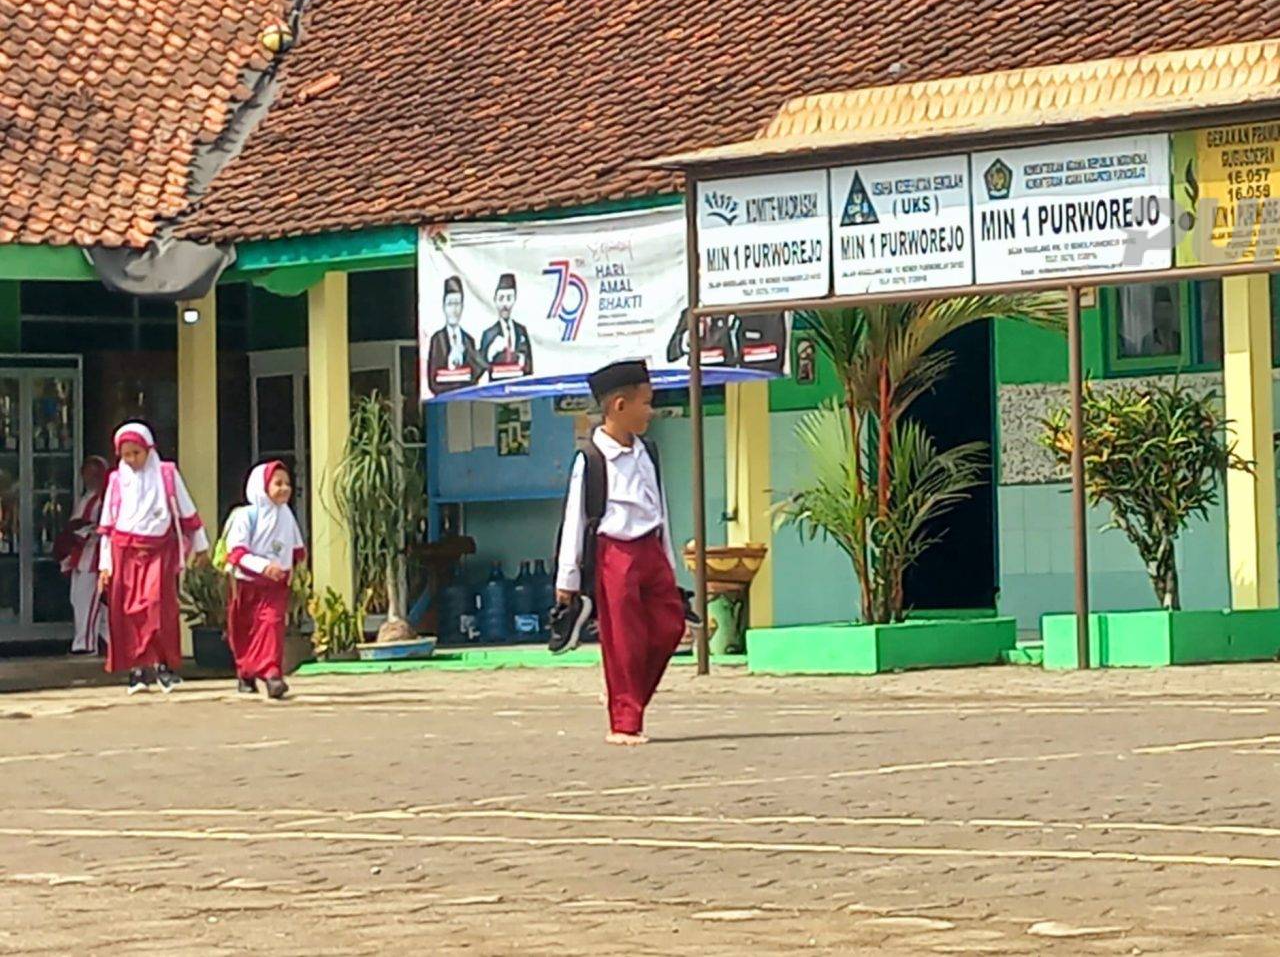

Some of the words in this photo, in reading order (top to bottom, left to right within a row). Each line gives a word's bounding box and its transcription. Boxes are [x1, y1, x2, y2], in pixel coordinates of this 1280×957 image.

[981, 207, 1015, 241] MIN
[1022, 206, 1031, 237] 1
[1038, 195, 1160, 236] PURWOREJO
[707, 245, 729, 272] MIN
[733, 244, 740, 270] 1
[744, 239, 822, 269] PURWOREJO
[841, 234, 865, 260] MIN
[870, 233, 876, 258] 1
[880, 226, 965, 257] PURWOREJO
[595, 263, 625, 279] HARI
[599, 279, 633, 295] AMAL
[599, 295, 642, 312] BHAKTI
